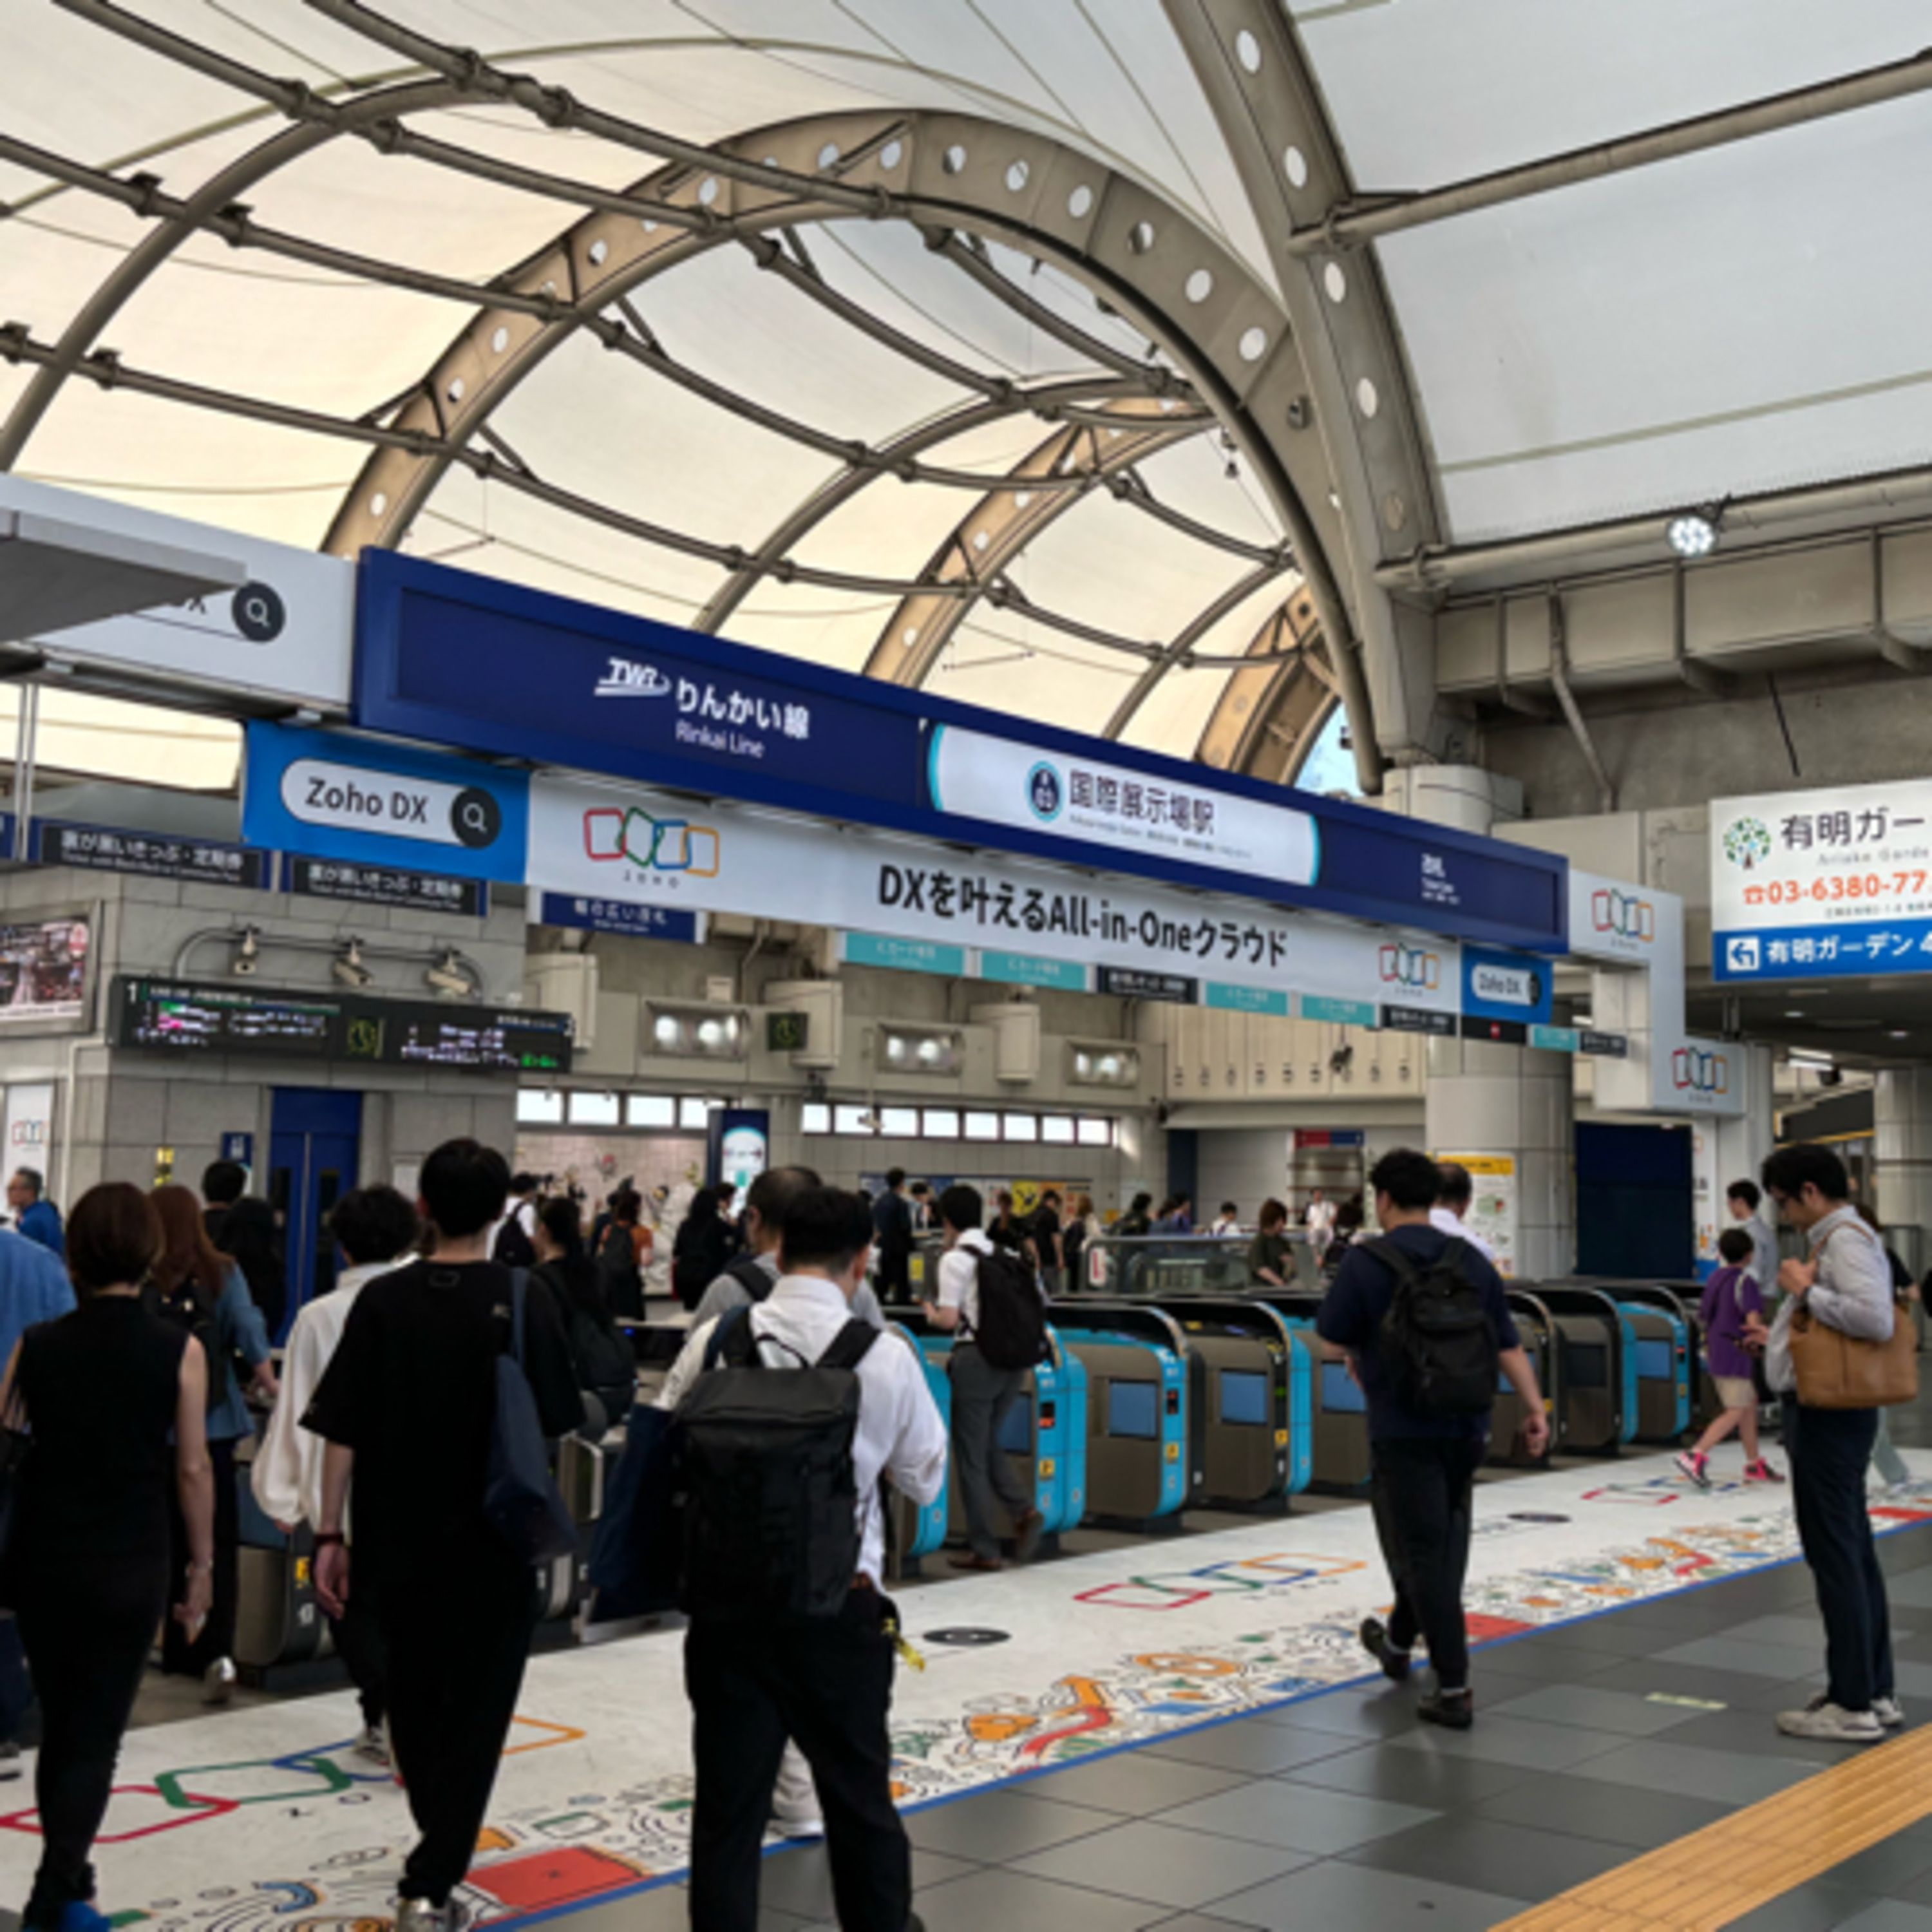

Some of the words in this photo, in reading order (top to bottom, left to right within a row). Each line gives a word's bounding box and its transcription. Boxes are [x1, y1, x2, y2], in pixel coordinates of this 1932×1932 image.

[677, 678, 809, 739] りんかい線
[676, 719, 726, 750] Rinkai
[730, 733, 765, 759] Line
[305, 776, 383, 817] Zoho
[390, 791, 429, 824] DX
[1070, 770, 1214, 835] 国際展示場駅
[1780, 806, 1925, 849] 有明ガー
[1767, 869, 1932, 905] 03-6380-77
[879, 864, 1288, 967] DXを叶えるAll-in-Oneクラウド
[1766, 931, 1914, 964] 有明ガーデン
